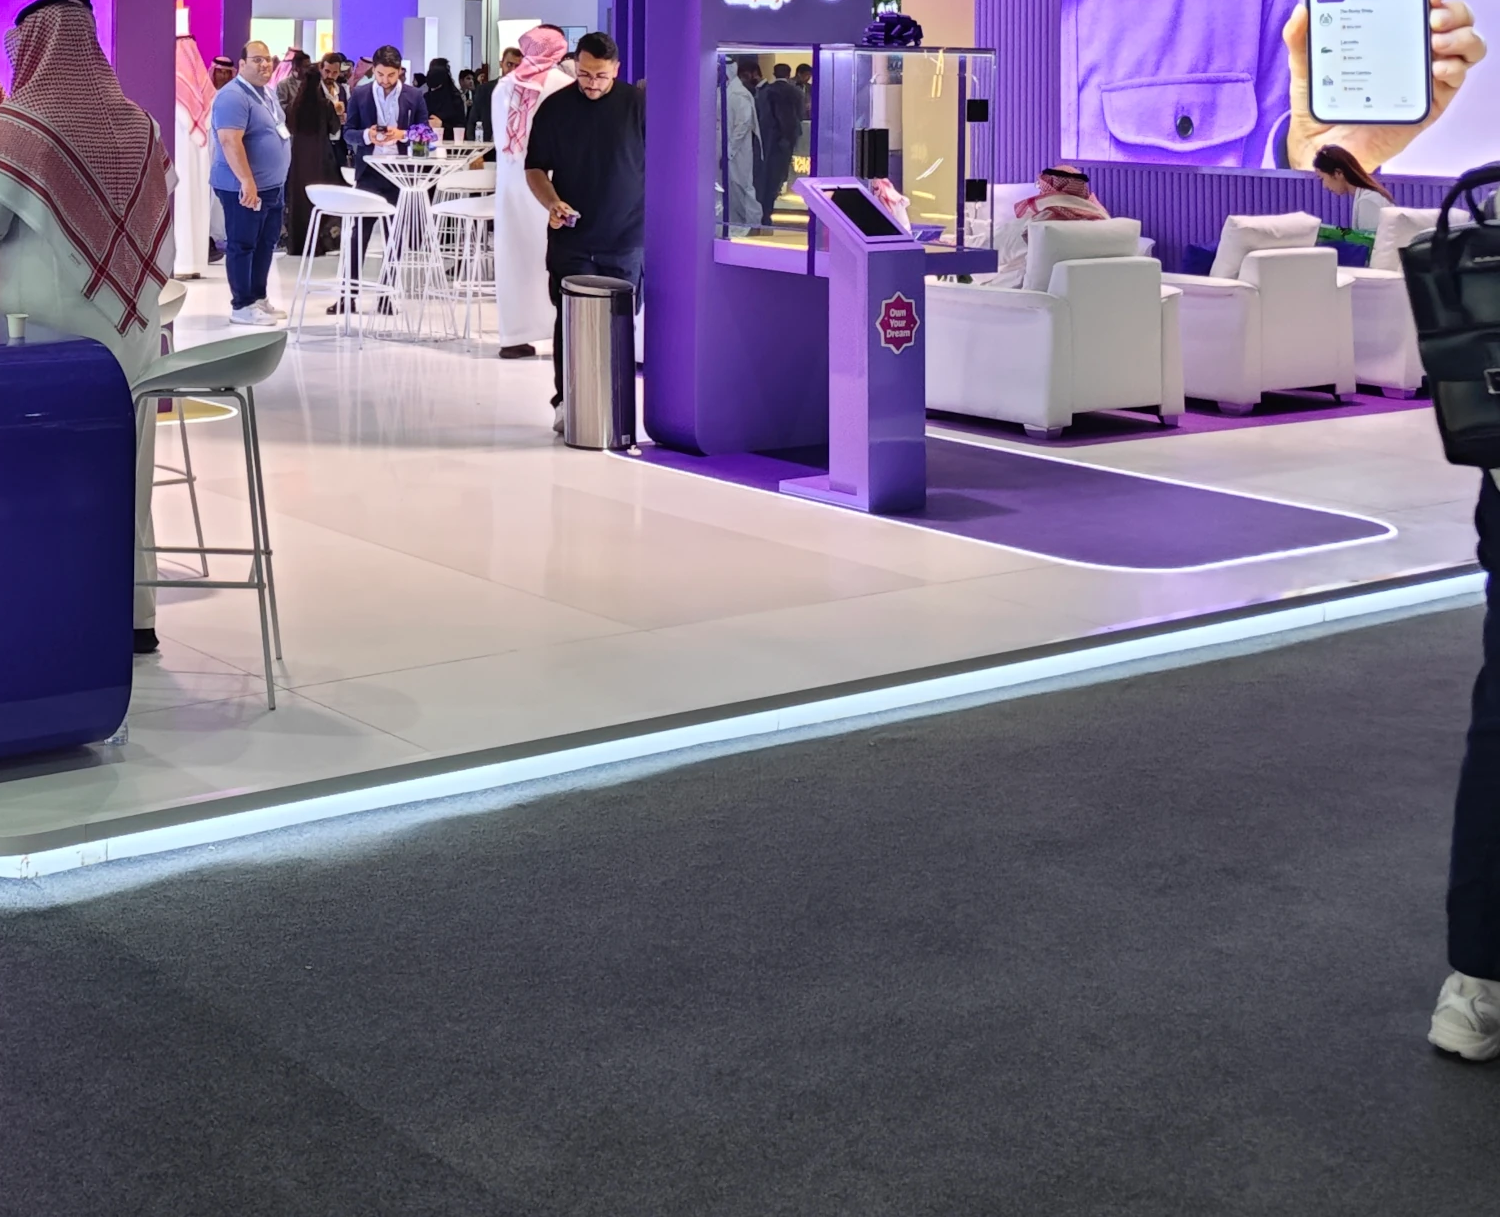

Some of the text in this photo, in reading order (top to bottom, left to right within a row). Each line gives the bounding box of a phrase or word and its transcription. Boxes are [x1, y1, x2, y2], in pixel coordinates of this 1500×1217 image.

[889, 308, 906, 317] Own
[889, 319, 906, 329] Your
[886, 329, 910, 338] Dream
